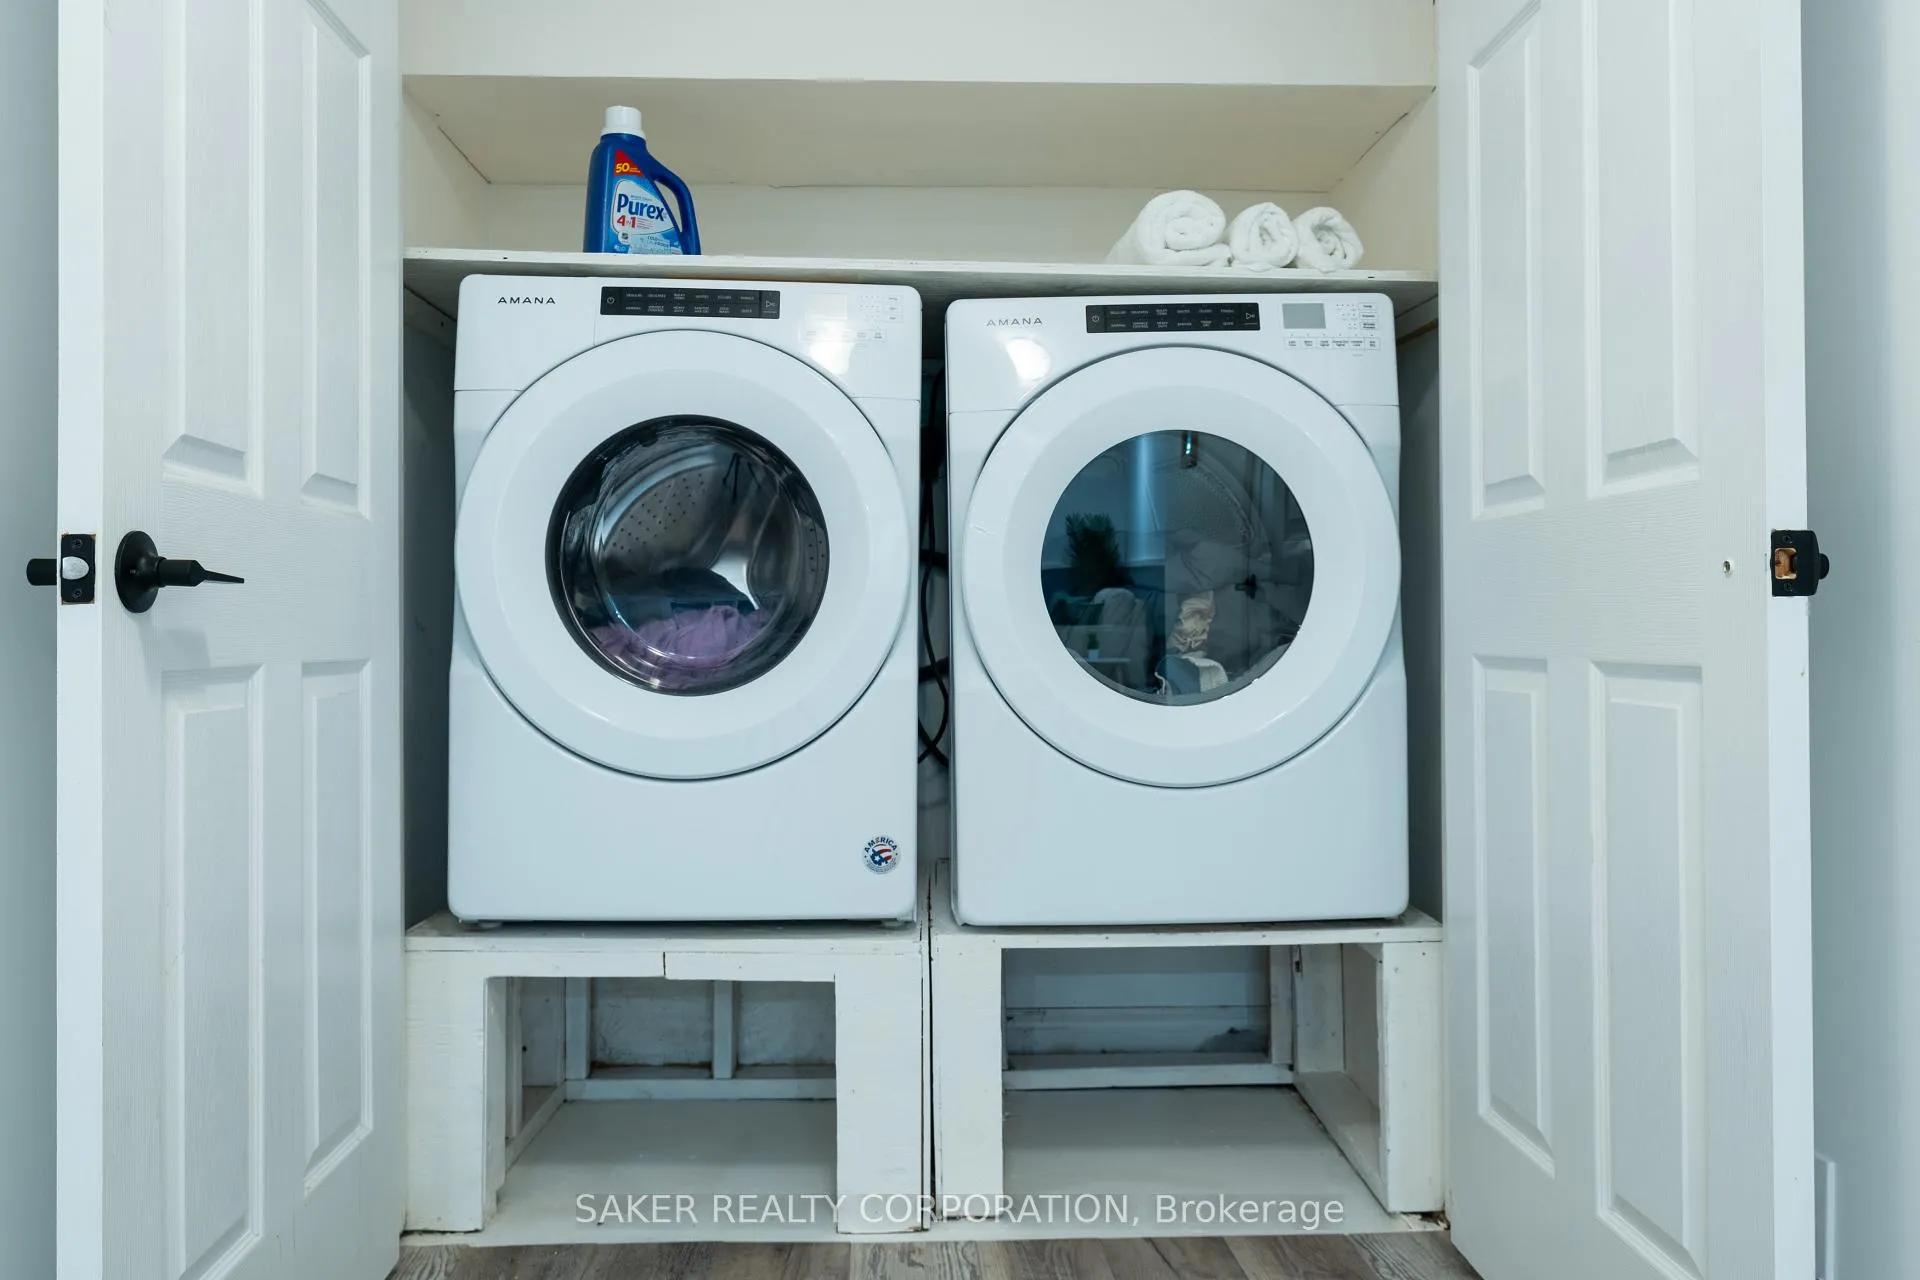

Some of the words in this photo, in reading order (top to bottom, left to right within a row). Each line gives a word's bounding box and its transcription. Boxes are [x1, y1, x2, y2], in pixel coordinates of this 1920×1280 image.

[616, 163, 630, 173] 50
[617, 193, 664, 221] Purex
[497, 296, 556, 304] AMANA
[986, 317, 1042, 326] AMANA
[864, 836, 897, 852] AMERICA
